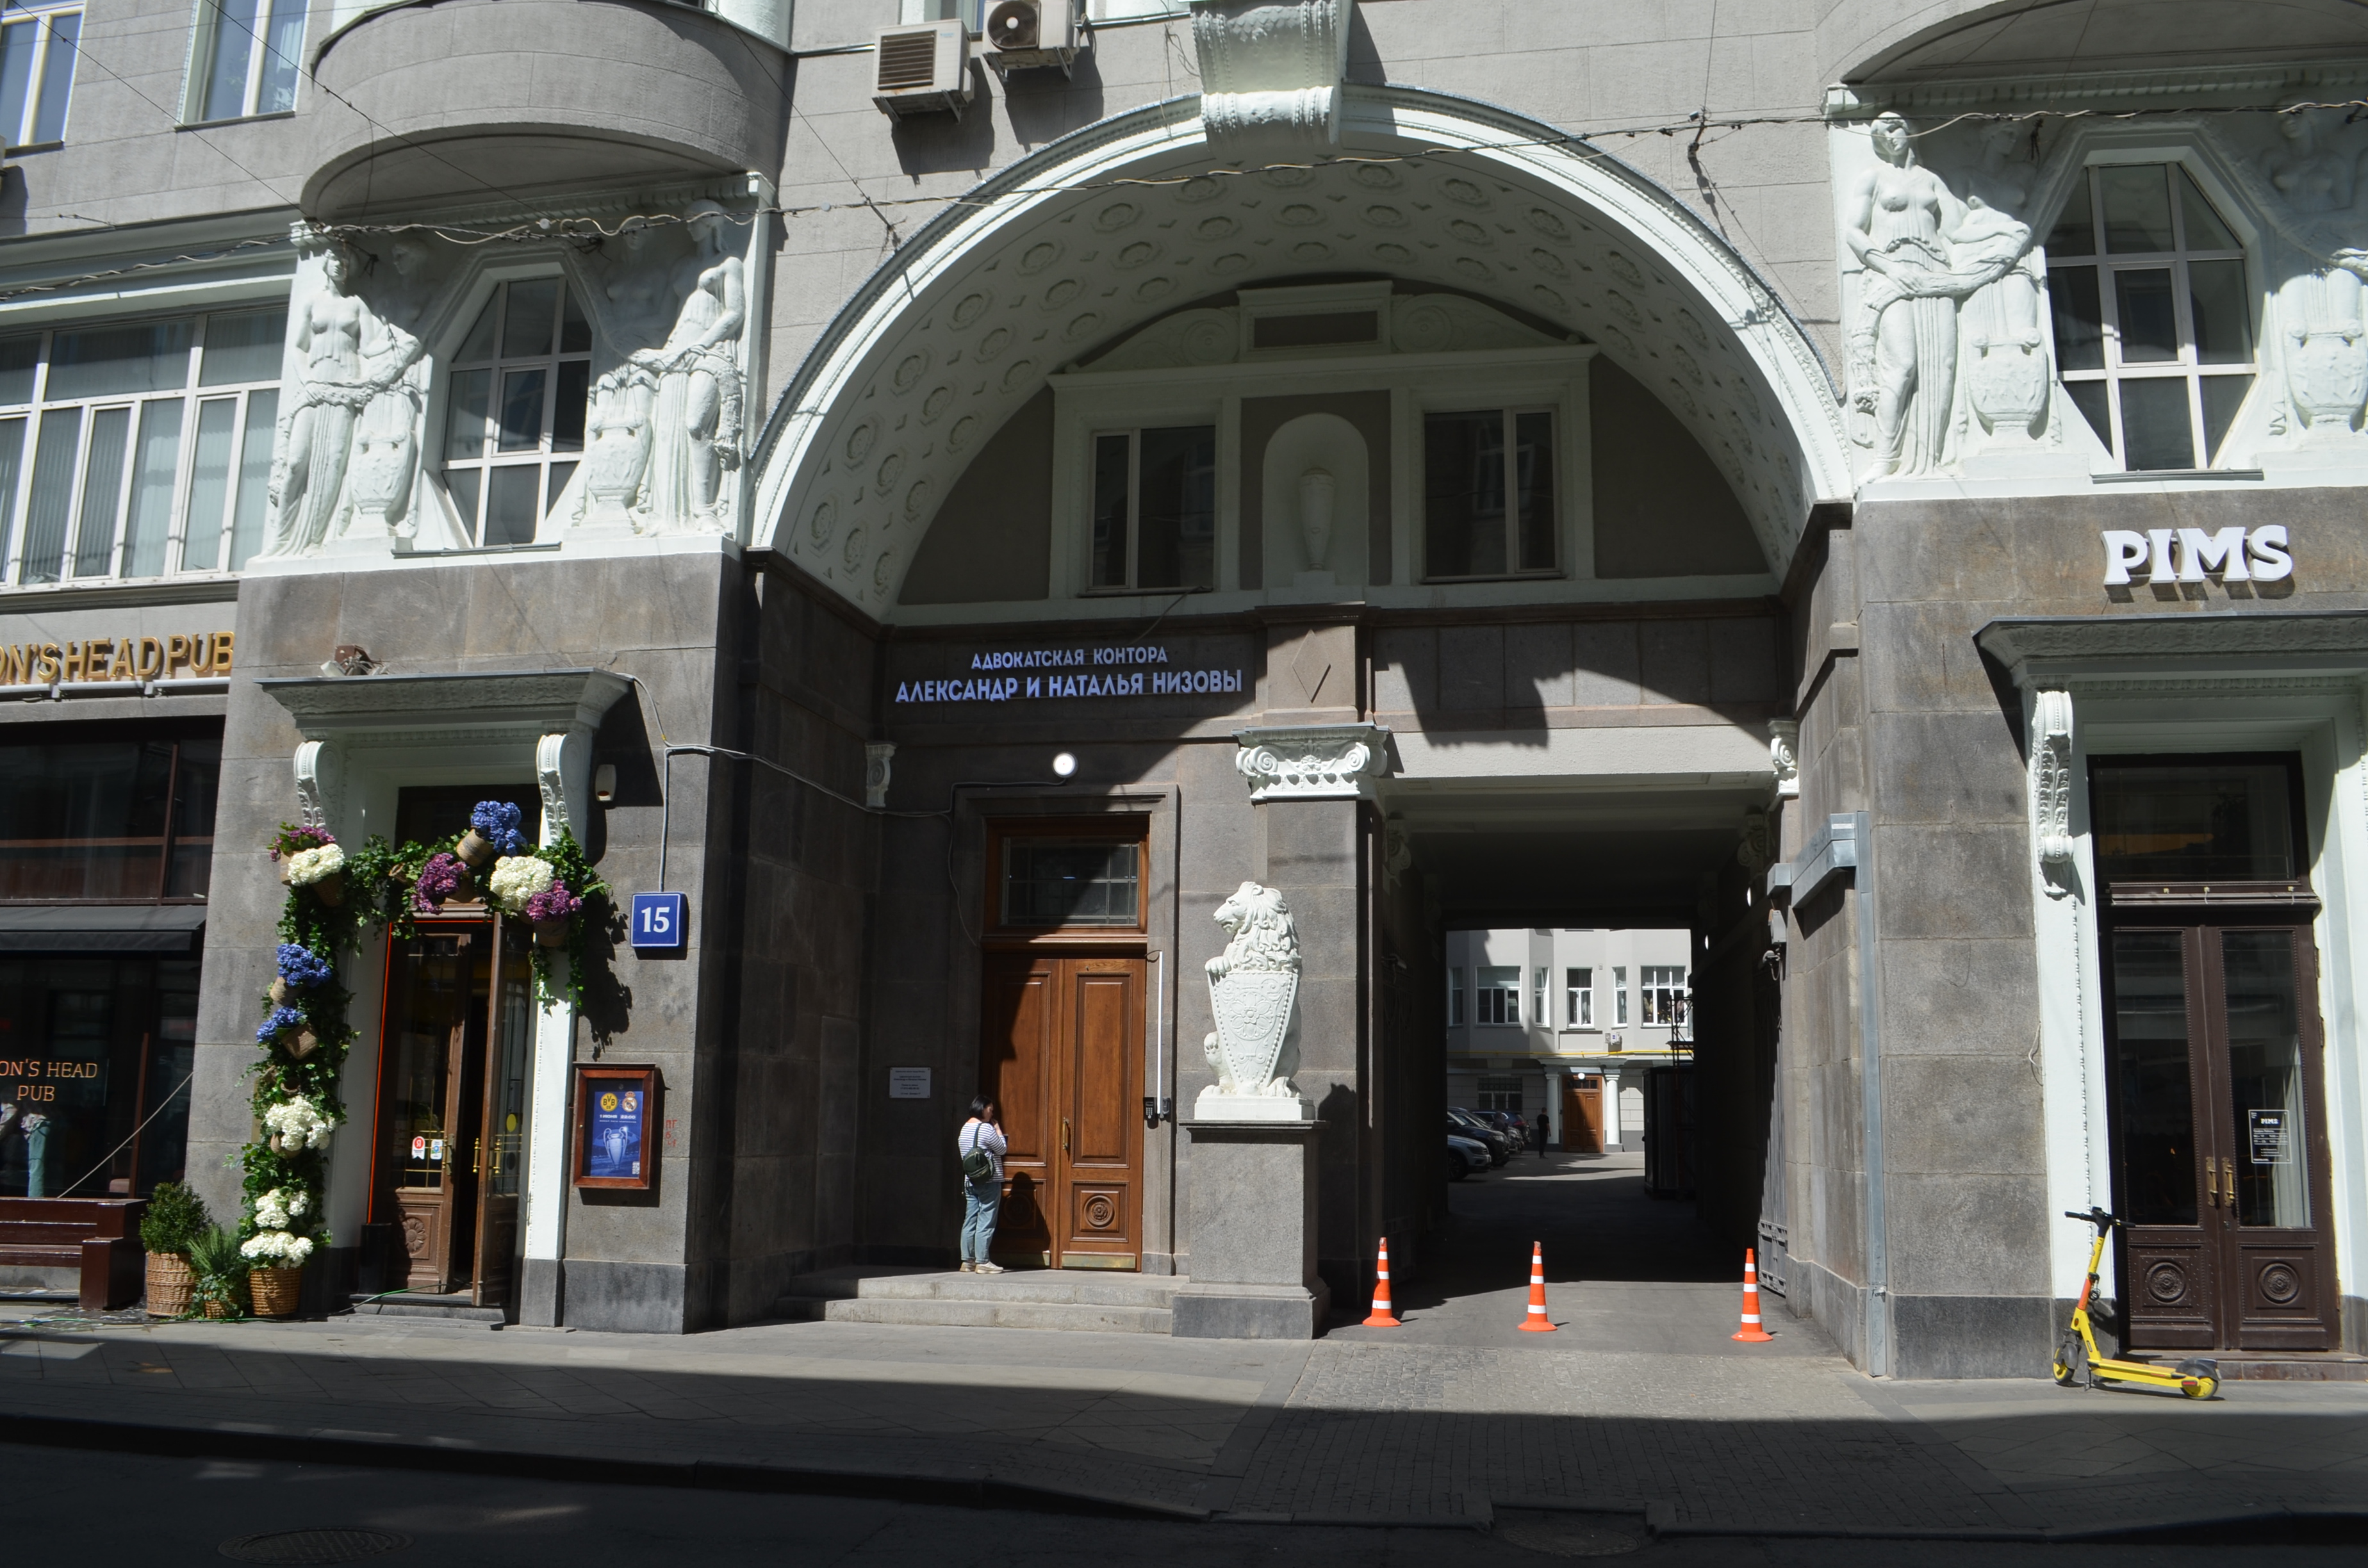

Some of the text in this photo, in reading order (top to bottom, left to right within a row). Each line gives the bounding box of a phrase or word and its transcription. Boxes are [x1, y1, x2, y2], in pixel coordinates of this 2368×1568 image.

[2100, 525, 2292, 585] PIMS
[62, 637, 160, 680] HEAD
[165, 631, 235, 674] PUB
[971, 646, 1169, 670] АДВОКАТСКАЯ КОНТОРА
[895, 669, 1242, 702] АЛЕКСАНДР И НАТАЛЬЯ НИЗОВЫ
[641, 907, 670, 933] 15
[46, 1062, 98, 1078] HEAD
[17, 1085, 55, 1102] PUB
[603, 1095, 616, 1106] BVB
